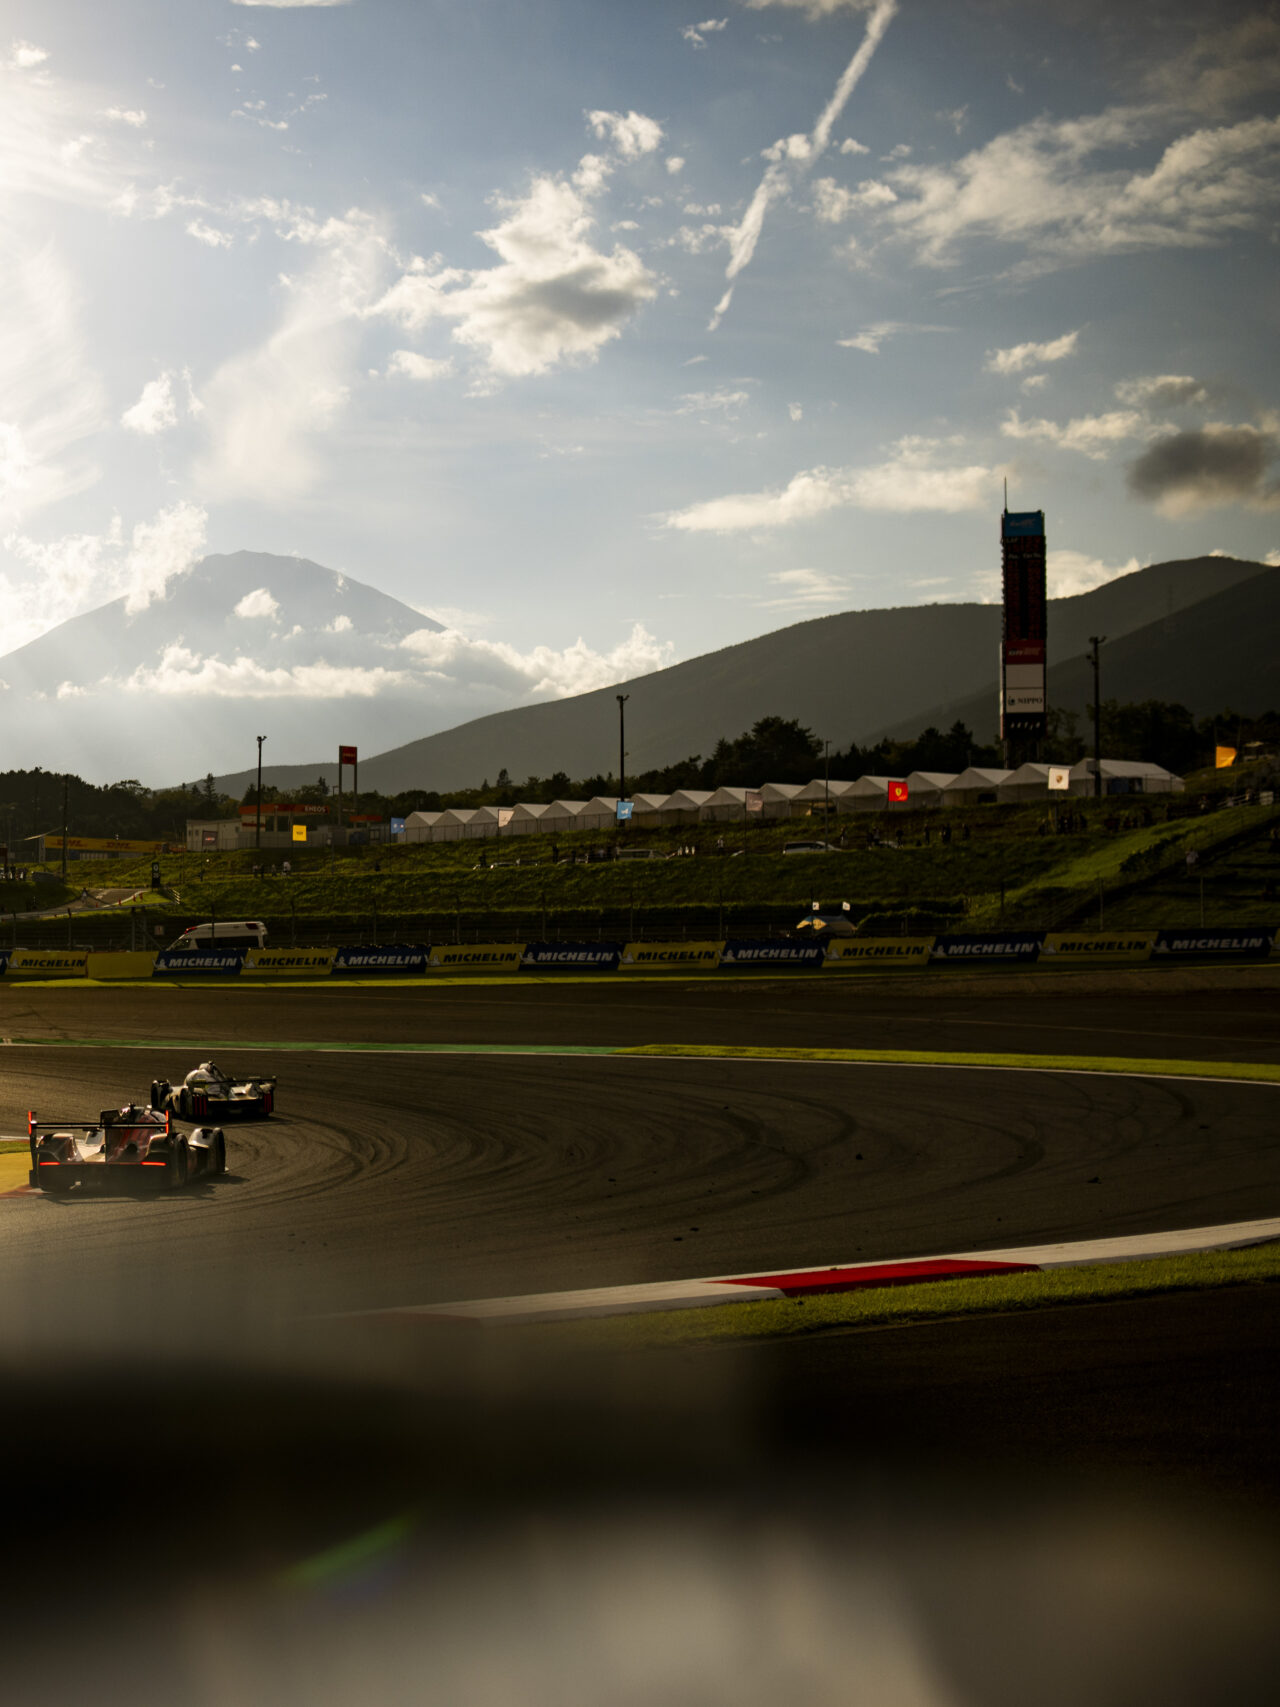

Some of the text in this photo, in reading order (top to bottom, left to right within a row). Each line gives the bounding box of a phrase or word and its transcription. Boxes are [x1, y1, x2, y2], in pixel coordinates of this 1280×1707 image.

[304, 805, 326, 813] ENEOS
[1060, 940, 1147, 950] MICHELIN
[1172, 938, 1263, 949] MICHELIN
[843, 946, 924, 956] MICHELIN
[948, 943, 1035, 954] MICHELIN
[444, 953, 517, 962] MICHELIN
[537, 952, 614, 961] MICHELIN
[638, 952, 715, 960] MICHELIN
[737, 949, 817, 959] MICHELIN
[21, 959, 86, 967] MICHELIN
[169, 957, 237, 967] MICHELIN
[258, 957, 328, 966] MICHELIN
[348, 956, 422, 965] MICHELIN
